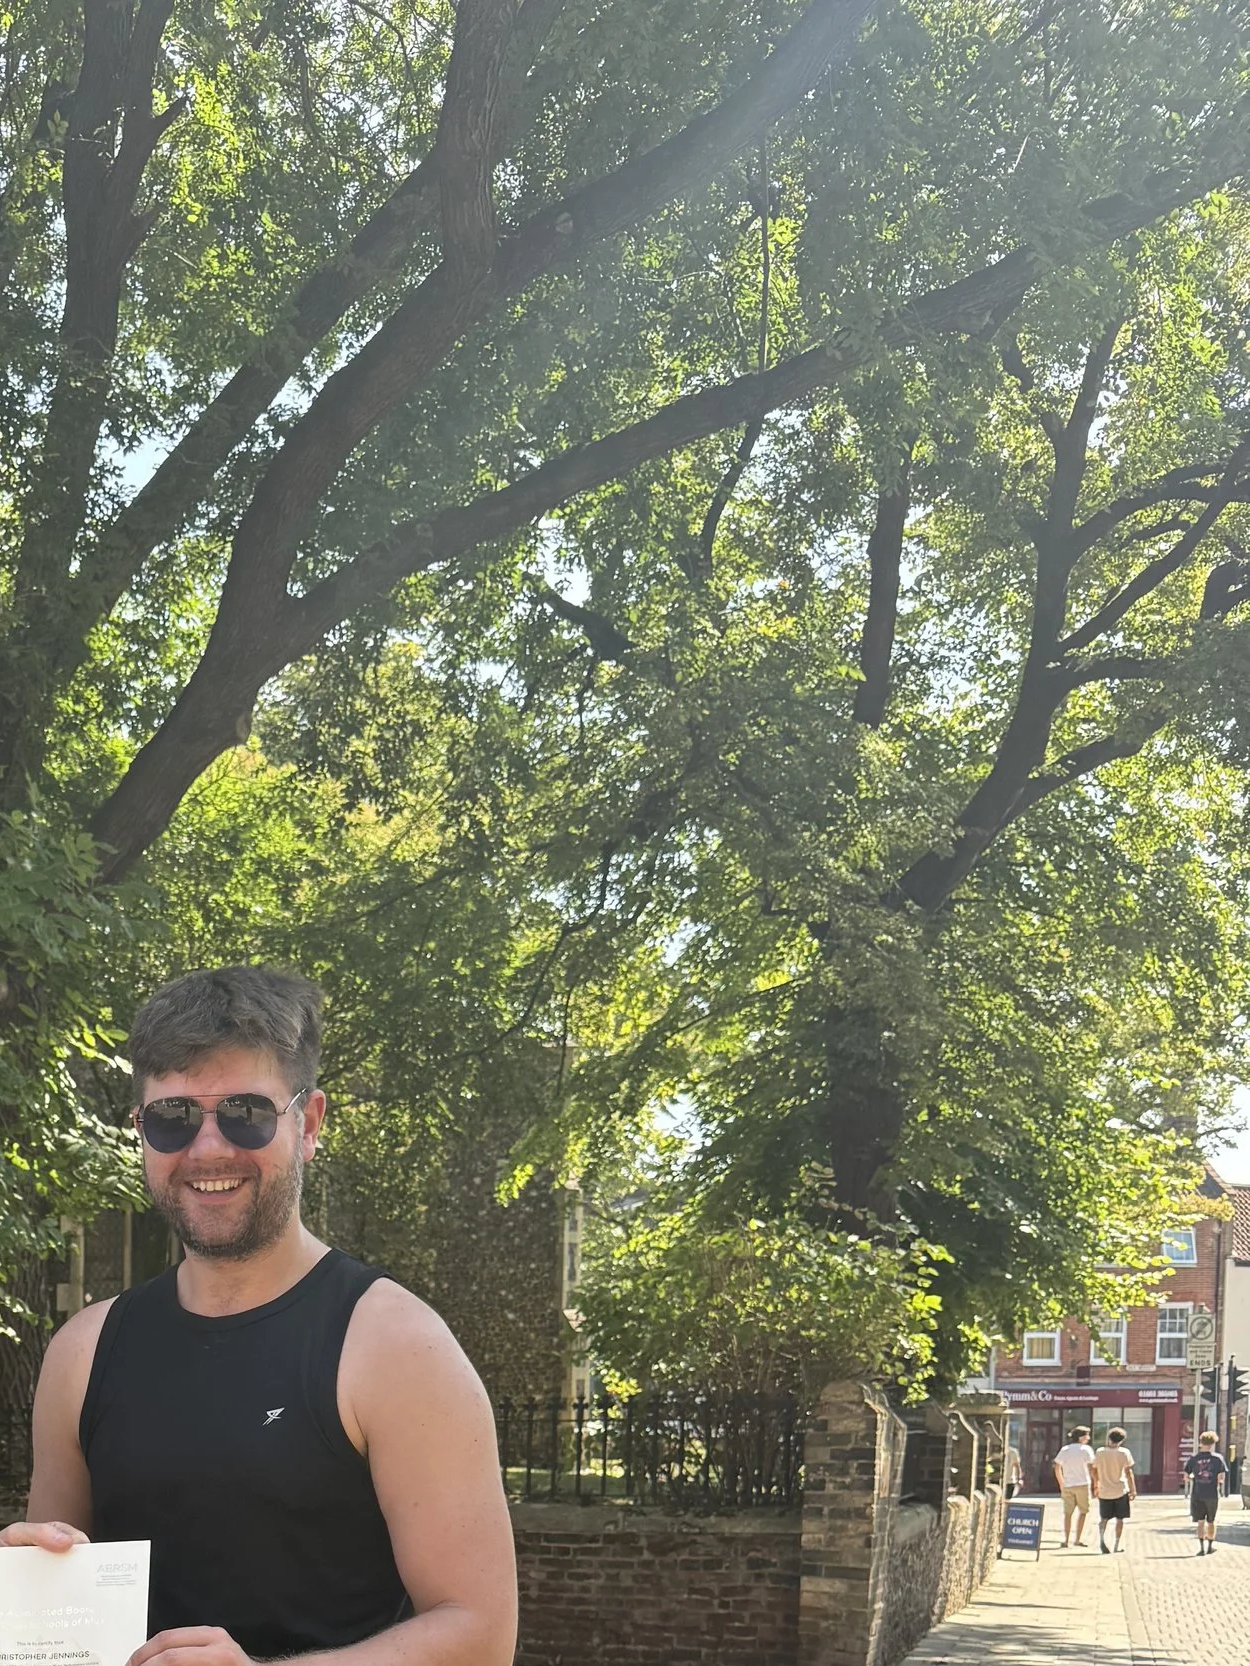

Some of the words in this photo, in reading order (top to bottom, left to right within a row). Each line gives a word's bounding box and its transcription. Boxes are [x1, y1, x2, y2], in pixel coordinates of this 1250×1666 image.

[1007, 1517, 1039, 1527] CHURCH
[1011, 1526, 1033, 1535] OPEN
[96, 1562, 138, 1574] ABRSM
[48, 1650, 90, 1660] JENNINGS
